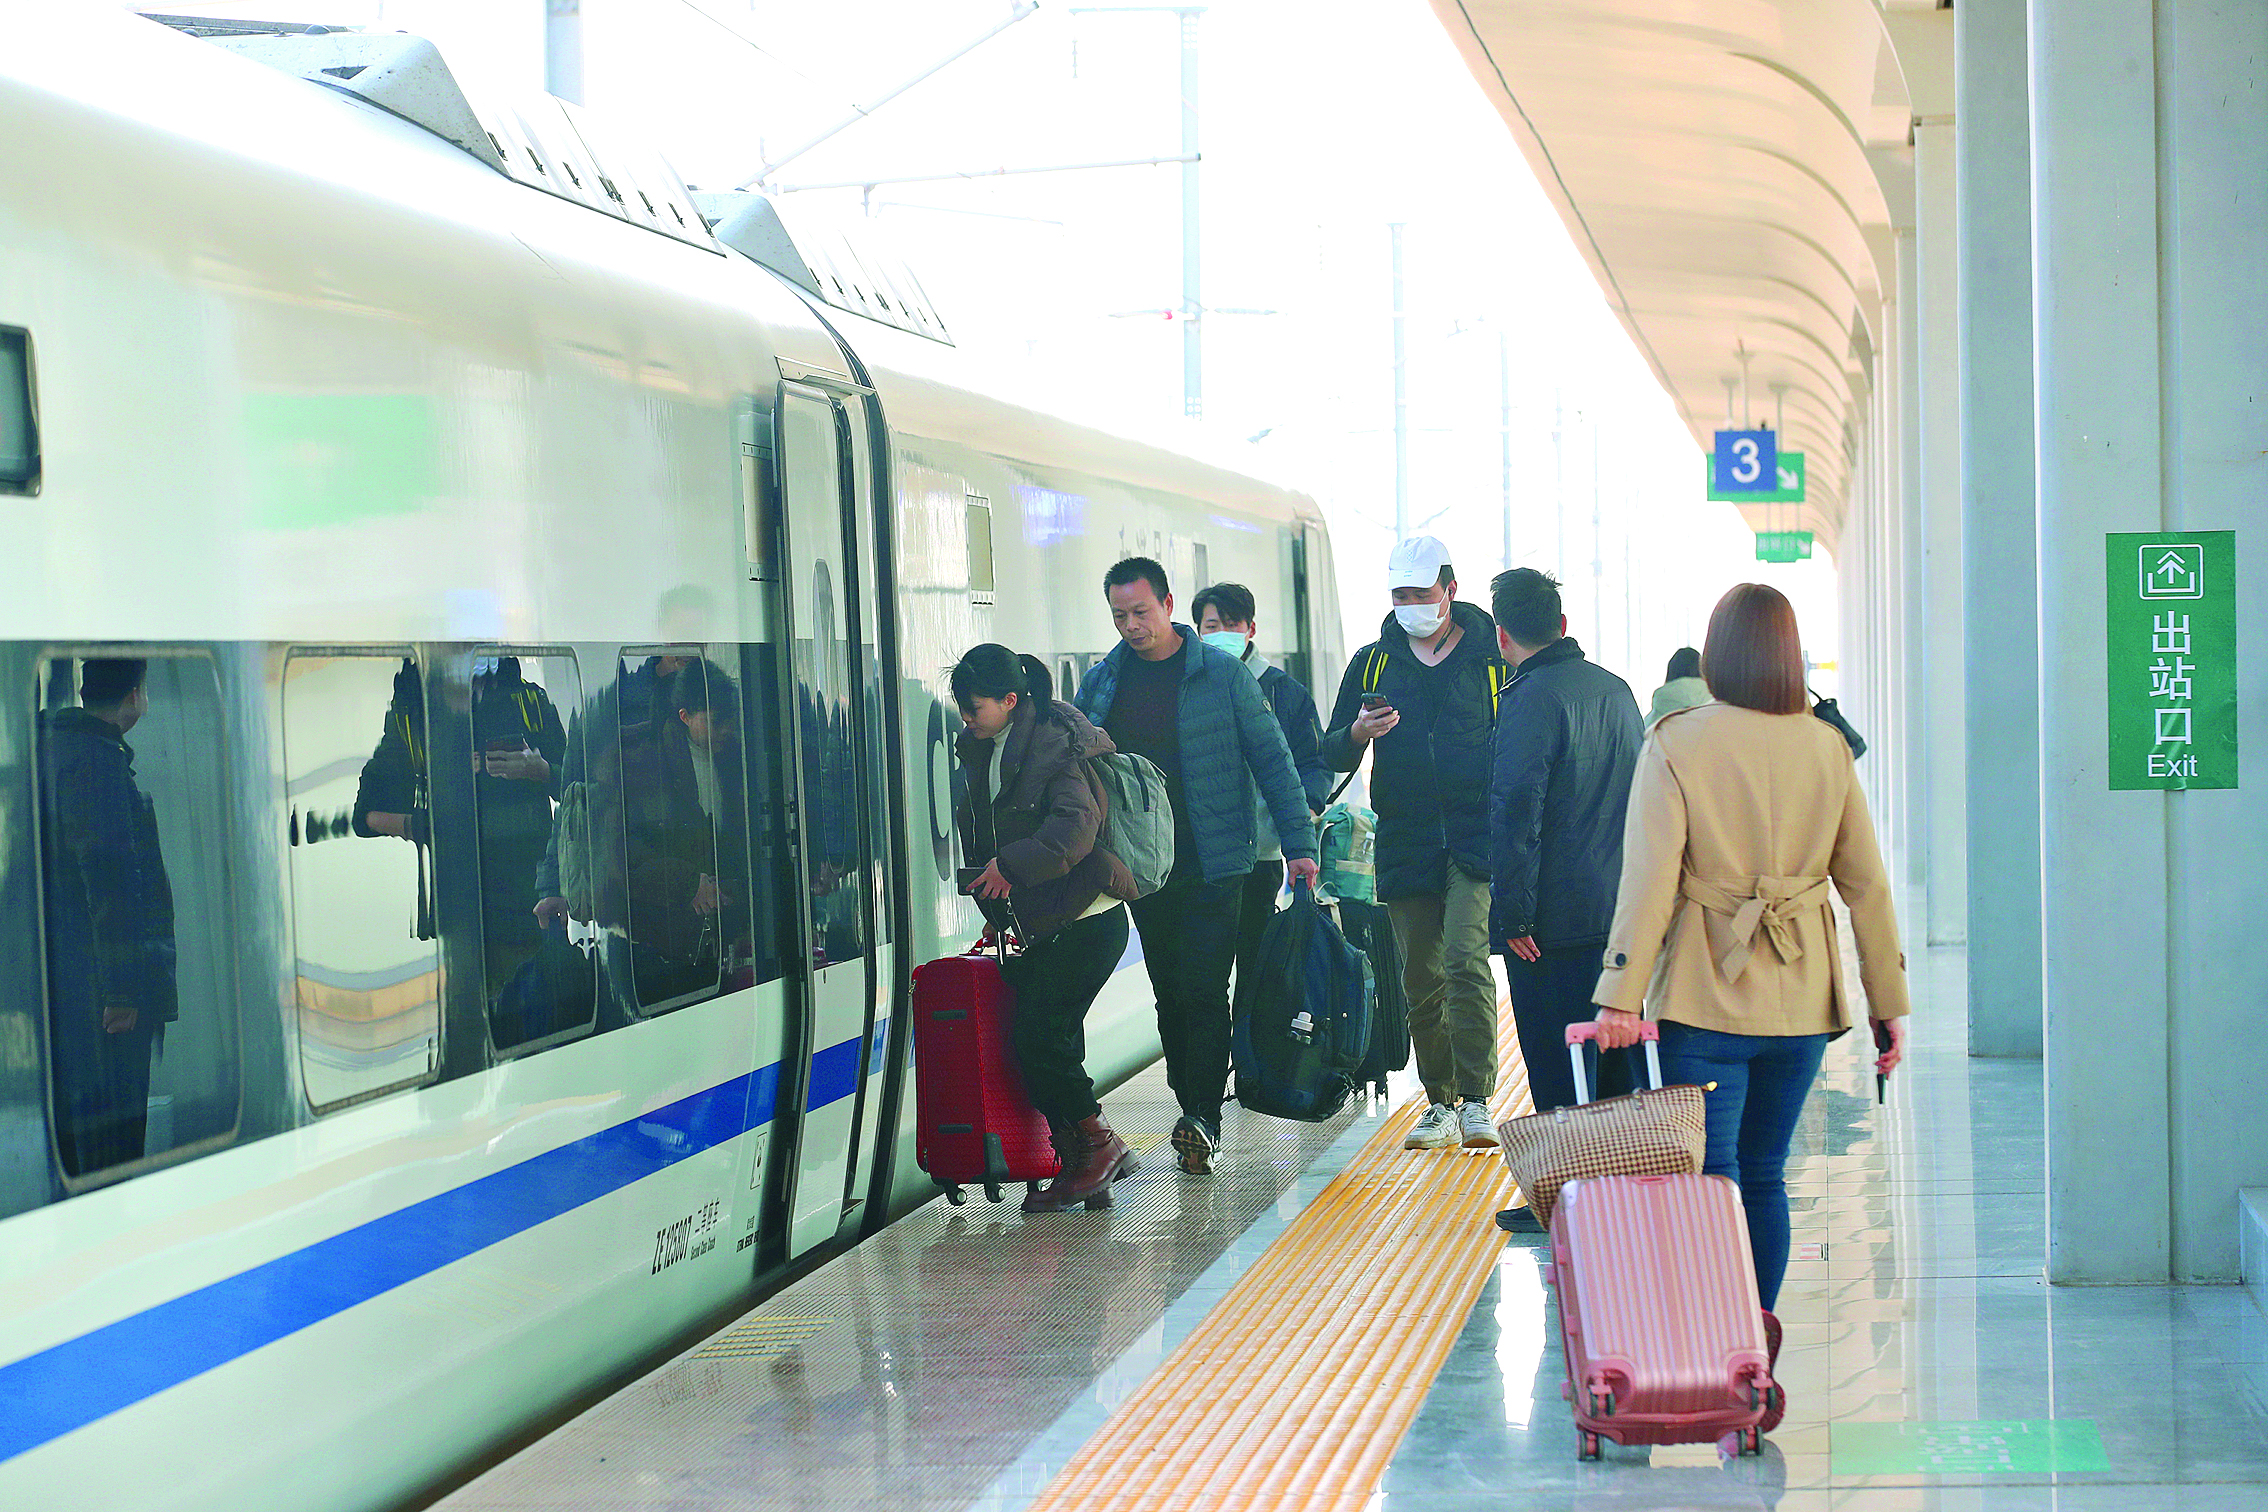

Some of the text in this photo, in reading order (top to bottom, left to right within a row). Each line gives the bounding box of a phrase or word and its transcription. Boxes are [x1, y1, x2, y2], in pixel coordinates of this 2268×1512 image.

[1731, 437, 1761, 484] 3
[2149, 610, 2196, 745] 出站口
[2147, 753, 2198, 777] Exit
